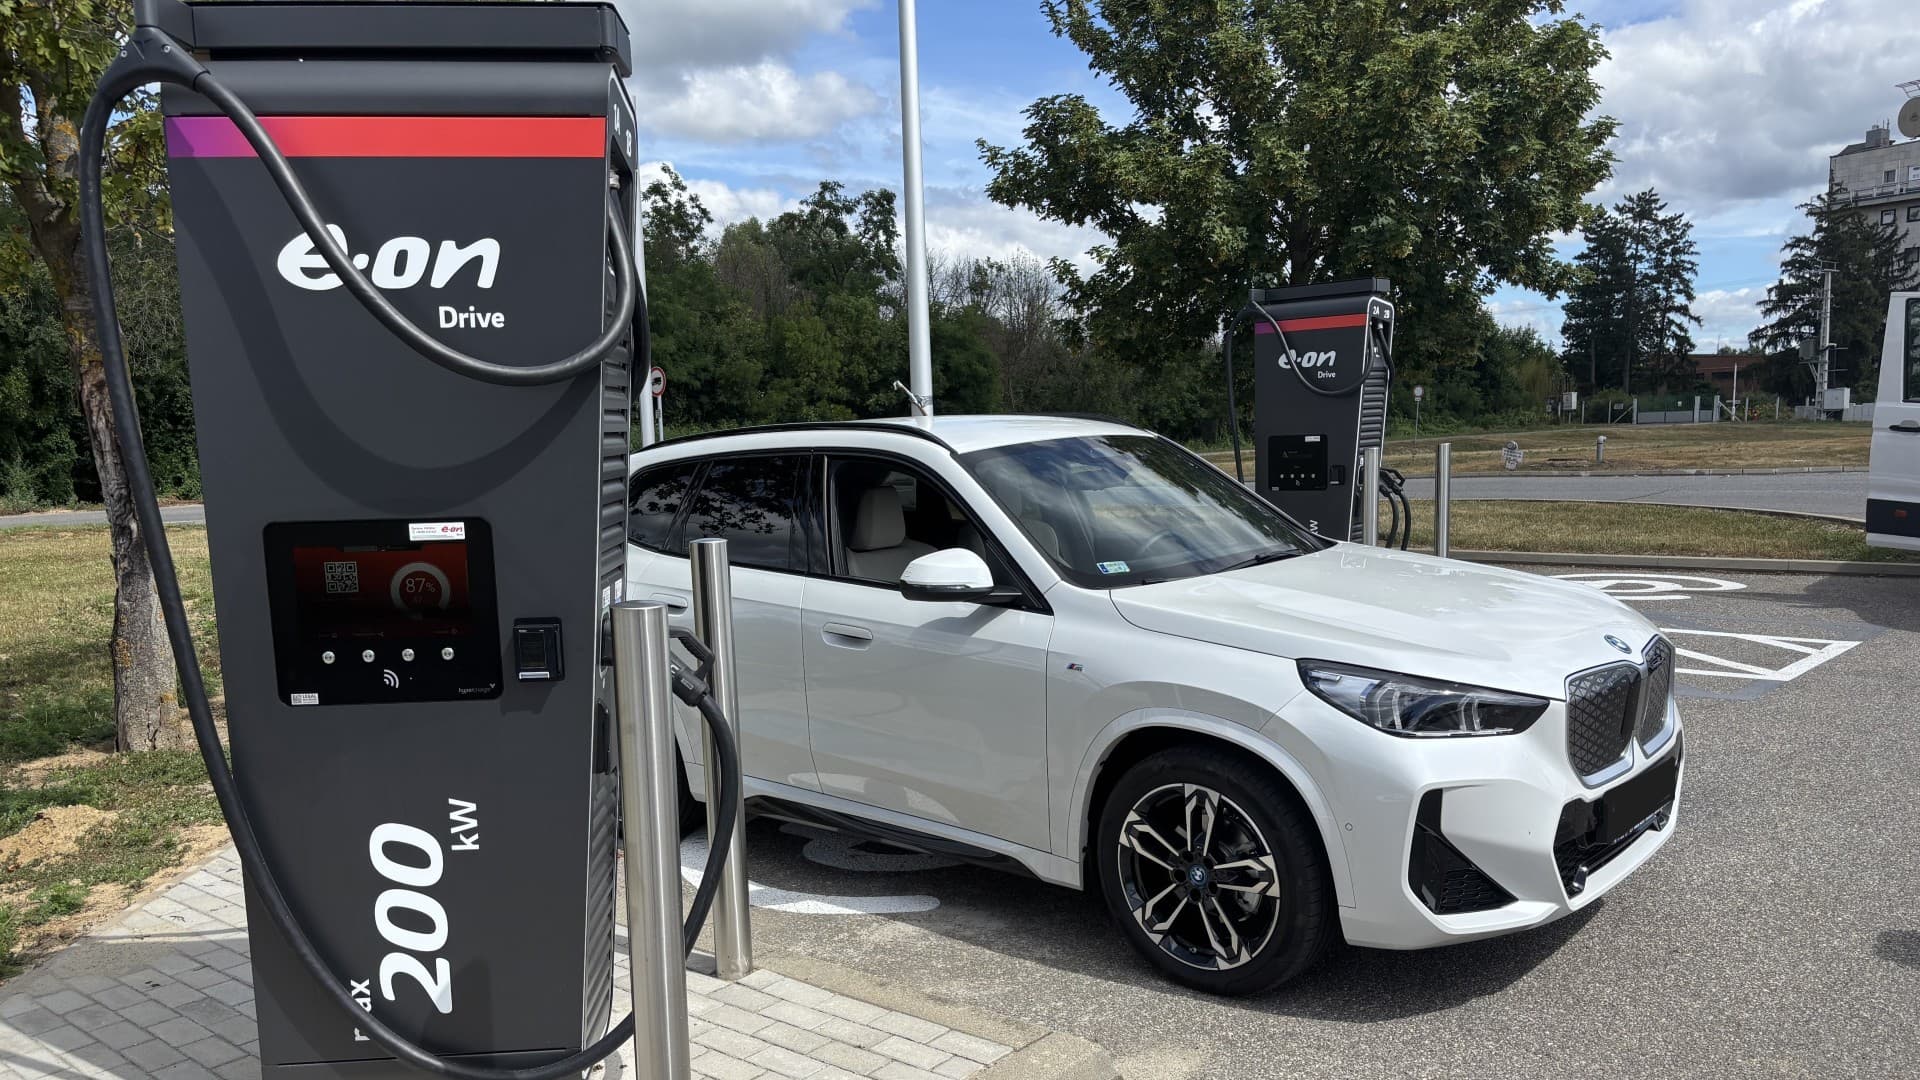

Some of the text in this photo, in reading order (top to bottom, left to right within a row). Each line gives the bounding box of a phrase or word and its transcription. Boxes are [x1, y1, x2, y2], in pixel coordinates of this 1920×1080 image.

[613, 103, 621, 136] 1A
[438, 306, 505, 329] Drive
[1372, 305, 1380, 316] 2A
[1383, 309, 1390, 319] 2B
[1317, 371, 1336, 379] Drive
[405, 577, 436, 594] 87%
[448, 798, 480, 852] kW
[369, 822, 453, 1014] 200
